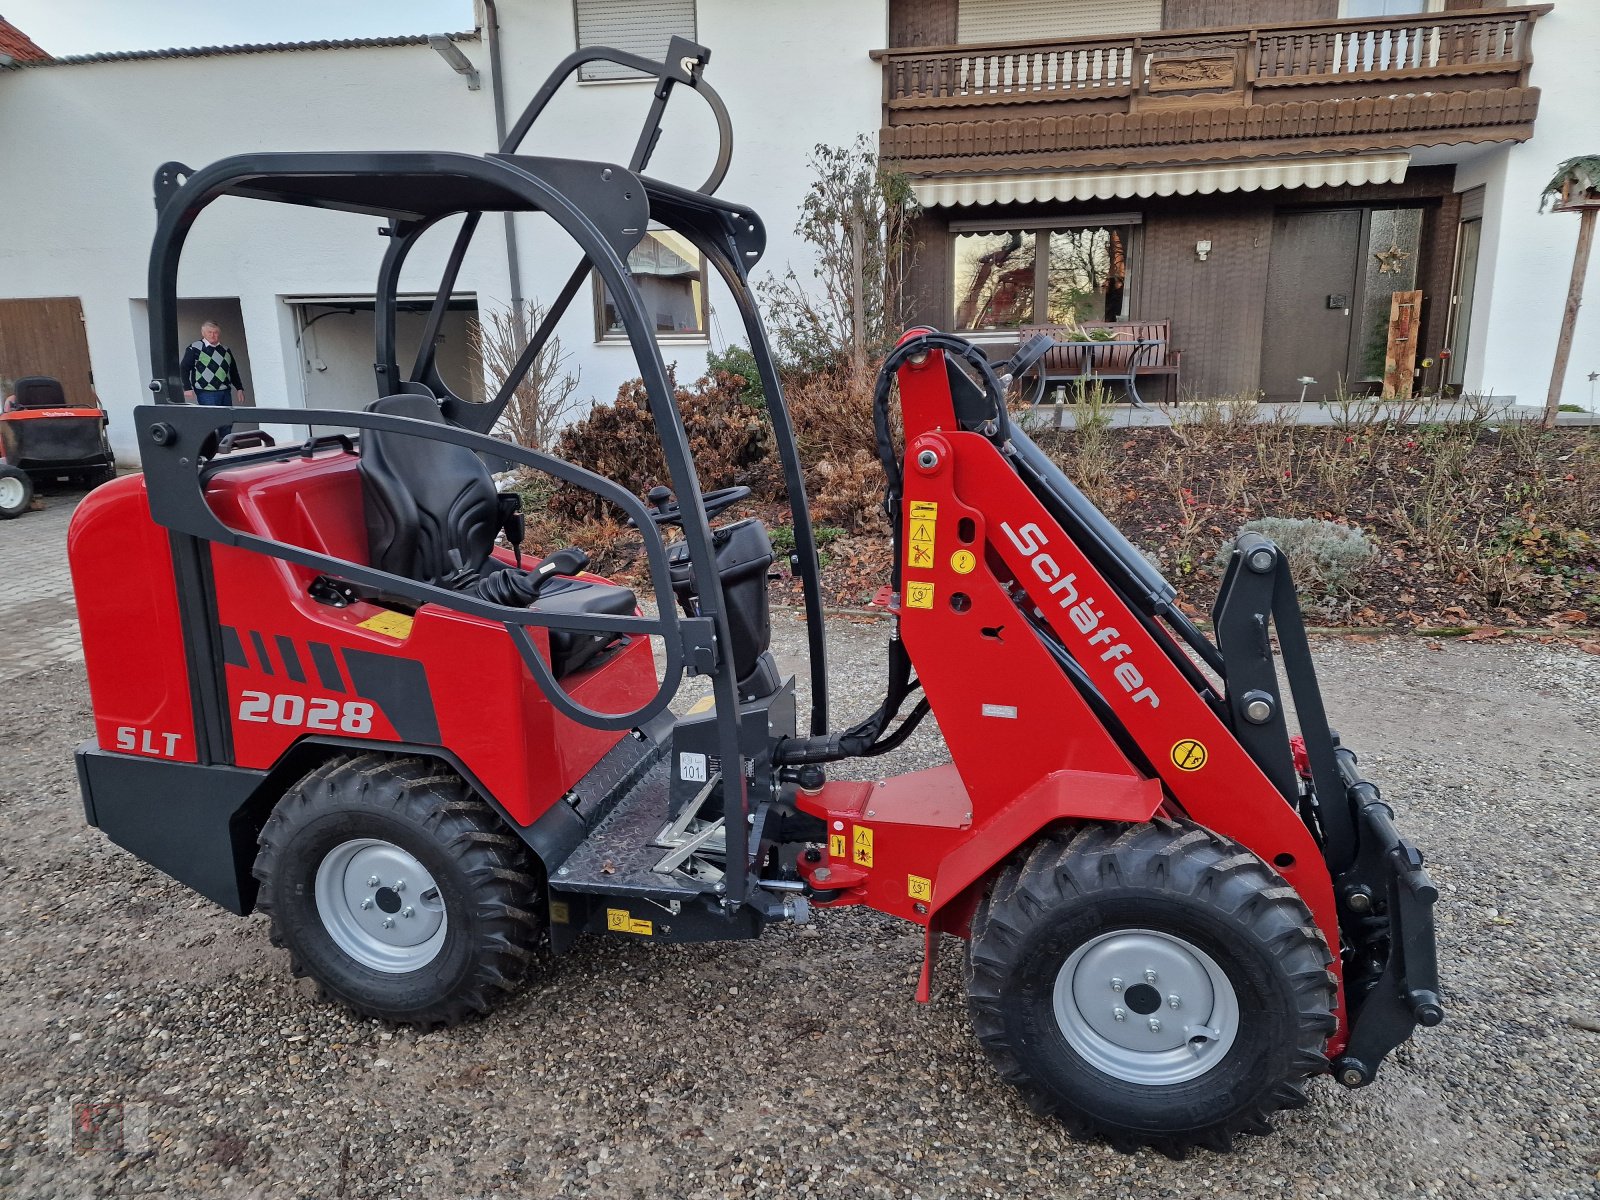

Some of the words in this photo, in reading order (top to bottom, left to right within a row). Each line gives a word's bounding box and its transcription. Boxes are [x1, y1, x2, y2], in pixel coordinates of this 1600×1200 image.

[1000, 521, 1160, 709] Schäffer
[238, 690, 375, 734] 2028
[116, 726, 182, 757] SLT
[683, 765, 700, 779] 101
